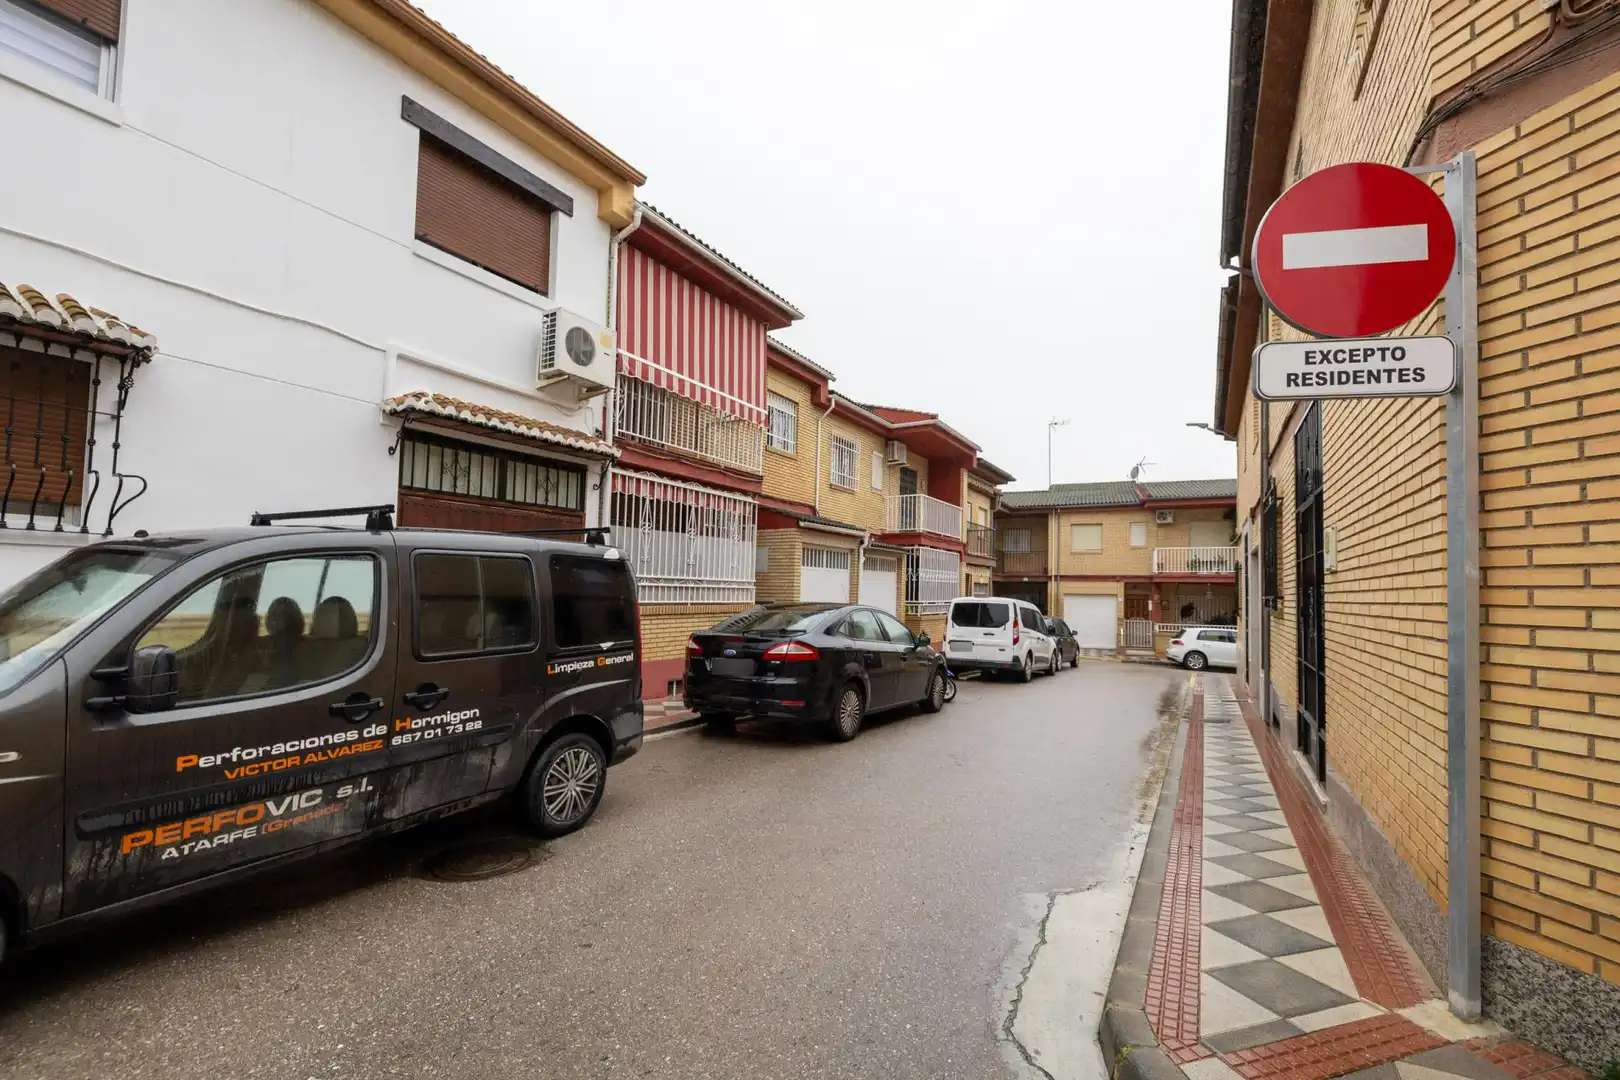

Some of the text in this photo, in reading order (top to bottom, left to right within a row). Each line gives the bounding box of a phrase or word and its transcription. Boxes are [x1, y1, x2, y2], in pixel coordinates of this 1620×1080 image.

[1304, 346, 1406, 365] EXCEPTO
[1286, 367, 1426, 388] RESIDENTES
[547, 652, 634, 676] Limpieza General
[176, 708, 480, 773] Perforaciones de Hormigon
[224, 755, 301, 780] VICTOR
[303, 739, 384, 765] ALVAREZ
[121, 788, 323, 855] PERFOVIC
[161, 826, 258, 860] ATARFE
